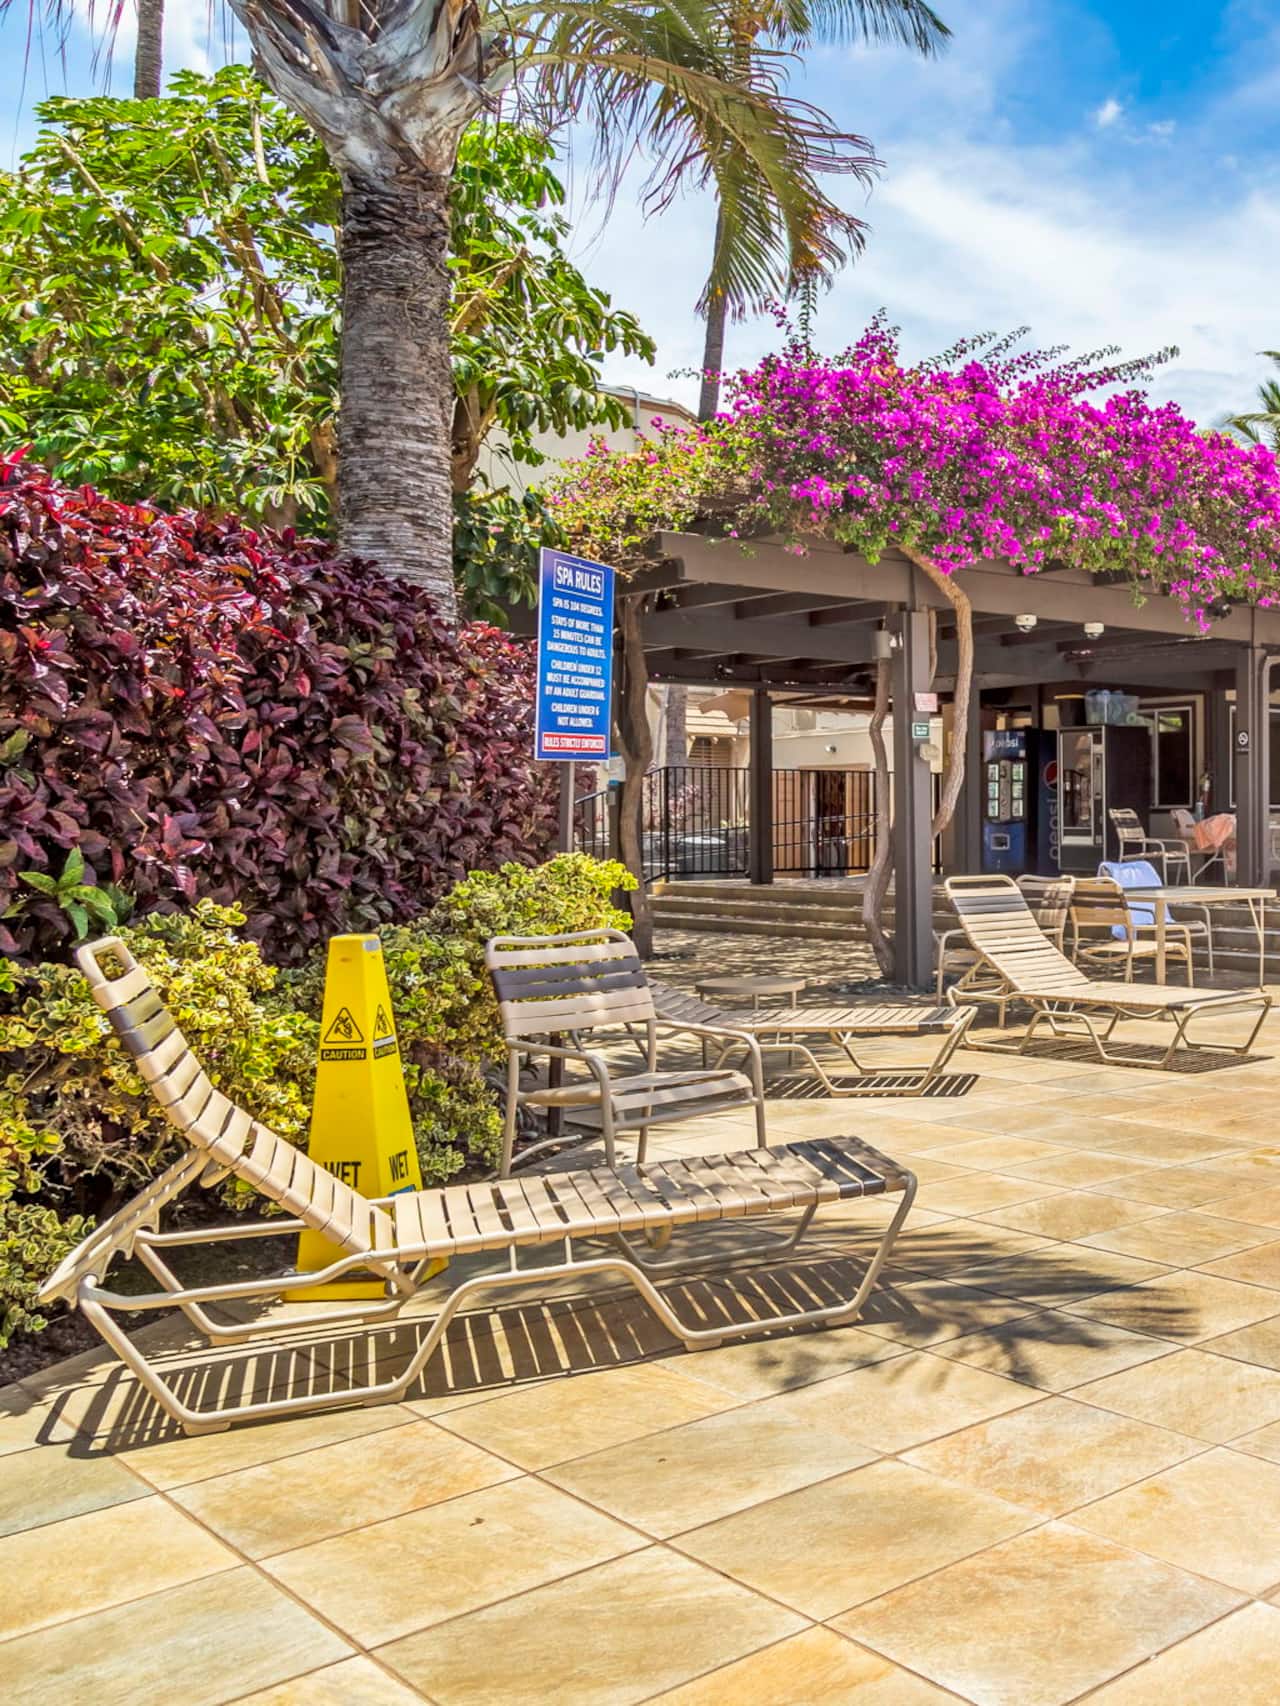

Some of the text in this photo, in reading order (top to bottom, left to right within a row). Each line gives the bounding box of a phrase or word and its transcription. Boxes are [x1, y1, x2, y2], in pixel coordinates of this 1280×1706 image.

[557, 566, 601, 593] SPA RULES
[552, 597, 562, 608] SPA
[564, 600, 569, 609] IS
[322, 1050, 365, 1059] CAUTION
[389, 1150, 409, 1183] WET
